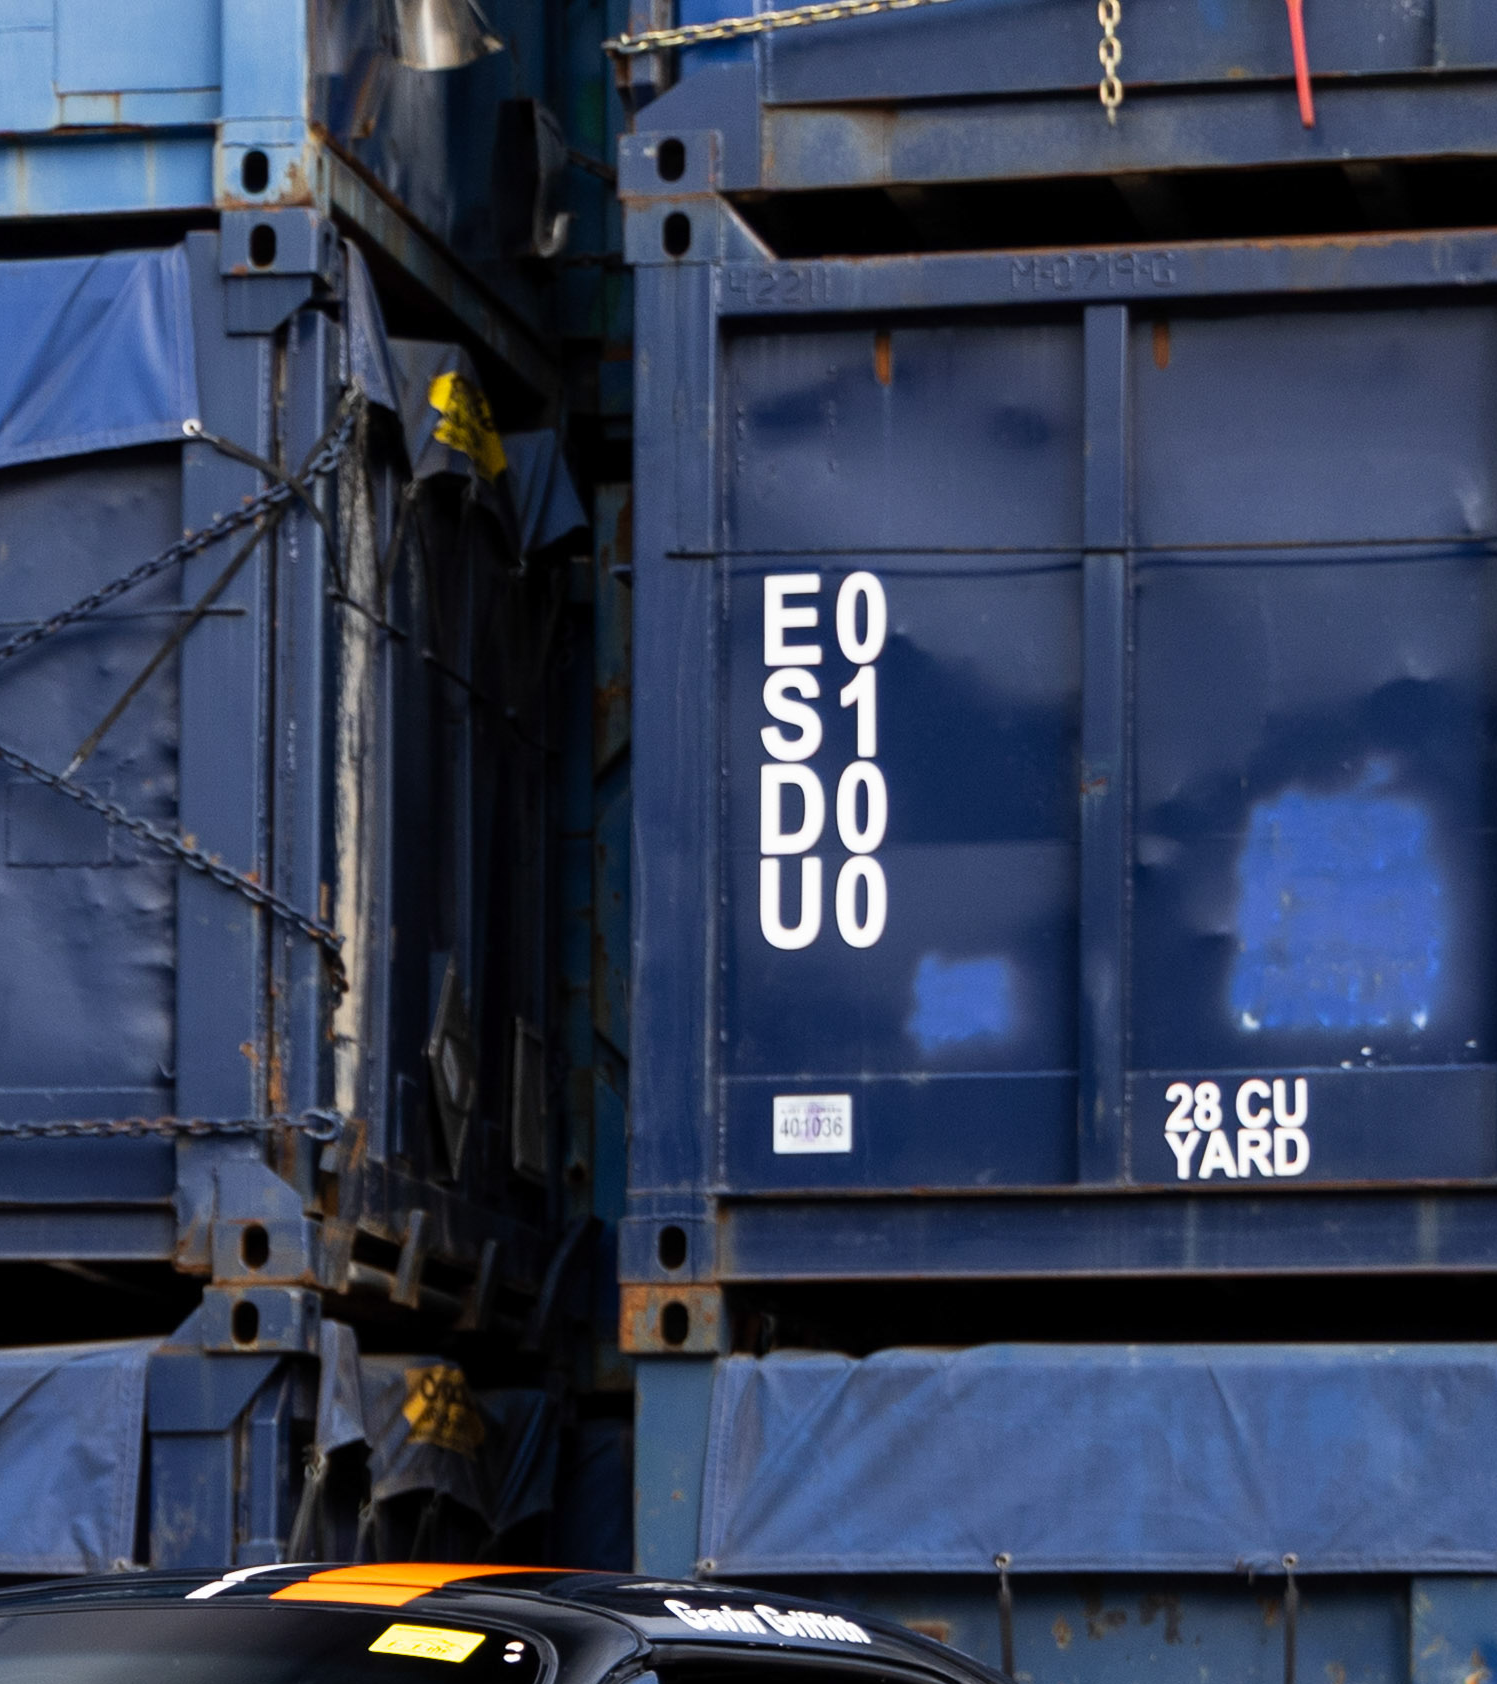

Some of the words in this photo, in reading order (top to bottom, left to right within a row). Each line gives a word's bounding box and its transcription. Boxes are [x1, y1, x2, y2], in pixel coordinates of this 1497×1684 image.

[779, 1116, 844, 1138] 401036
[1164, 1081, 1224, 1133] 28
[1235, 1078, 1309, 1129] CU
[1164, 1129, 1310, 1180] YARD
[663, 1599, 767, 1635] Gavin
